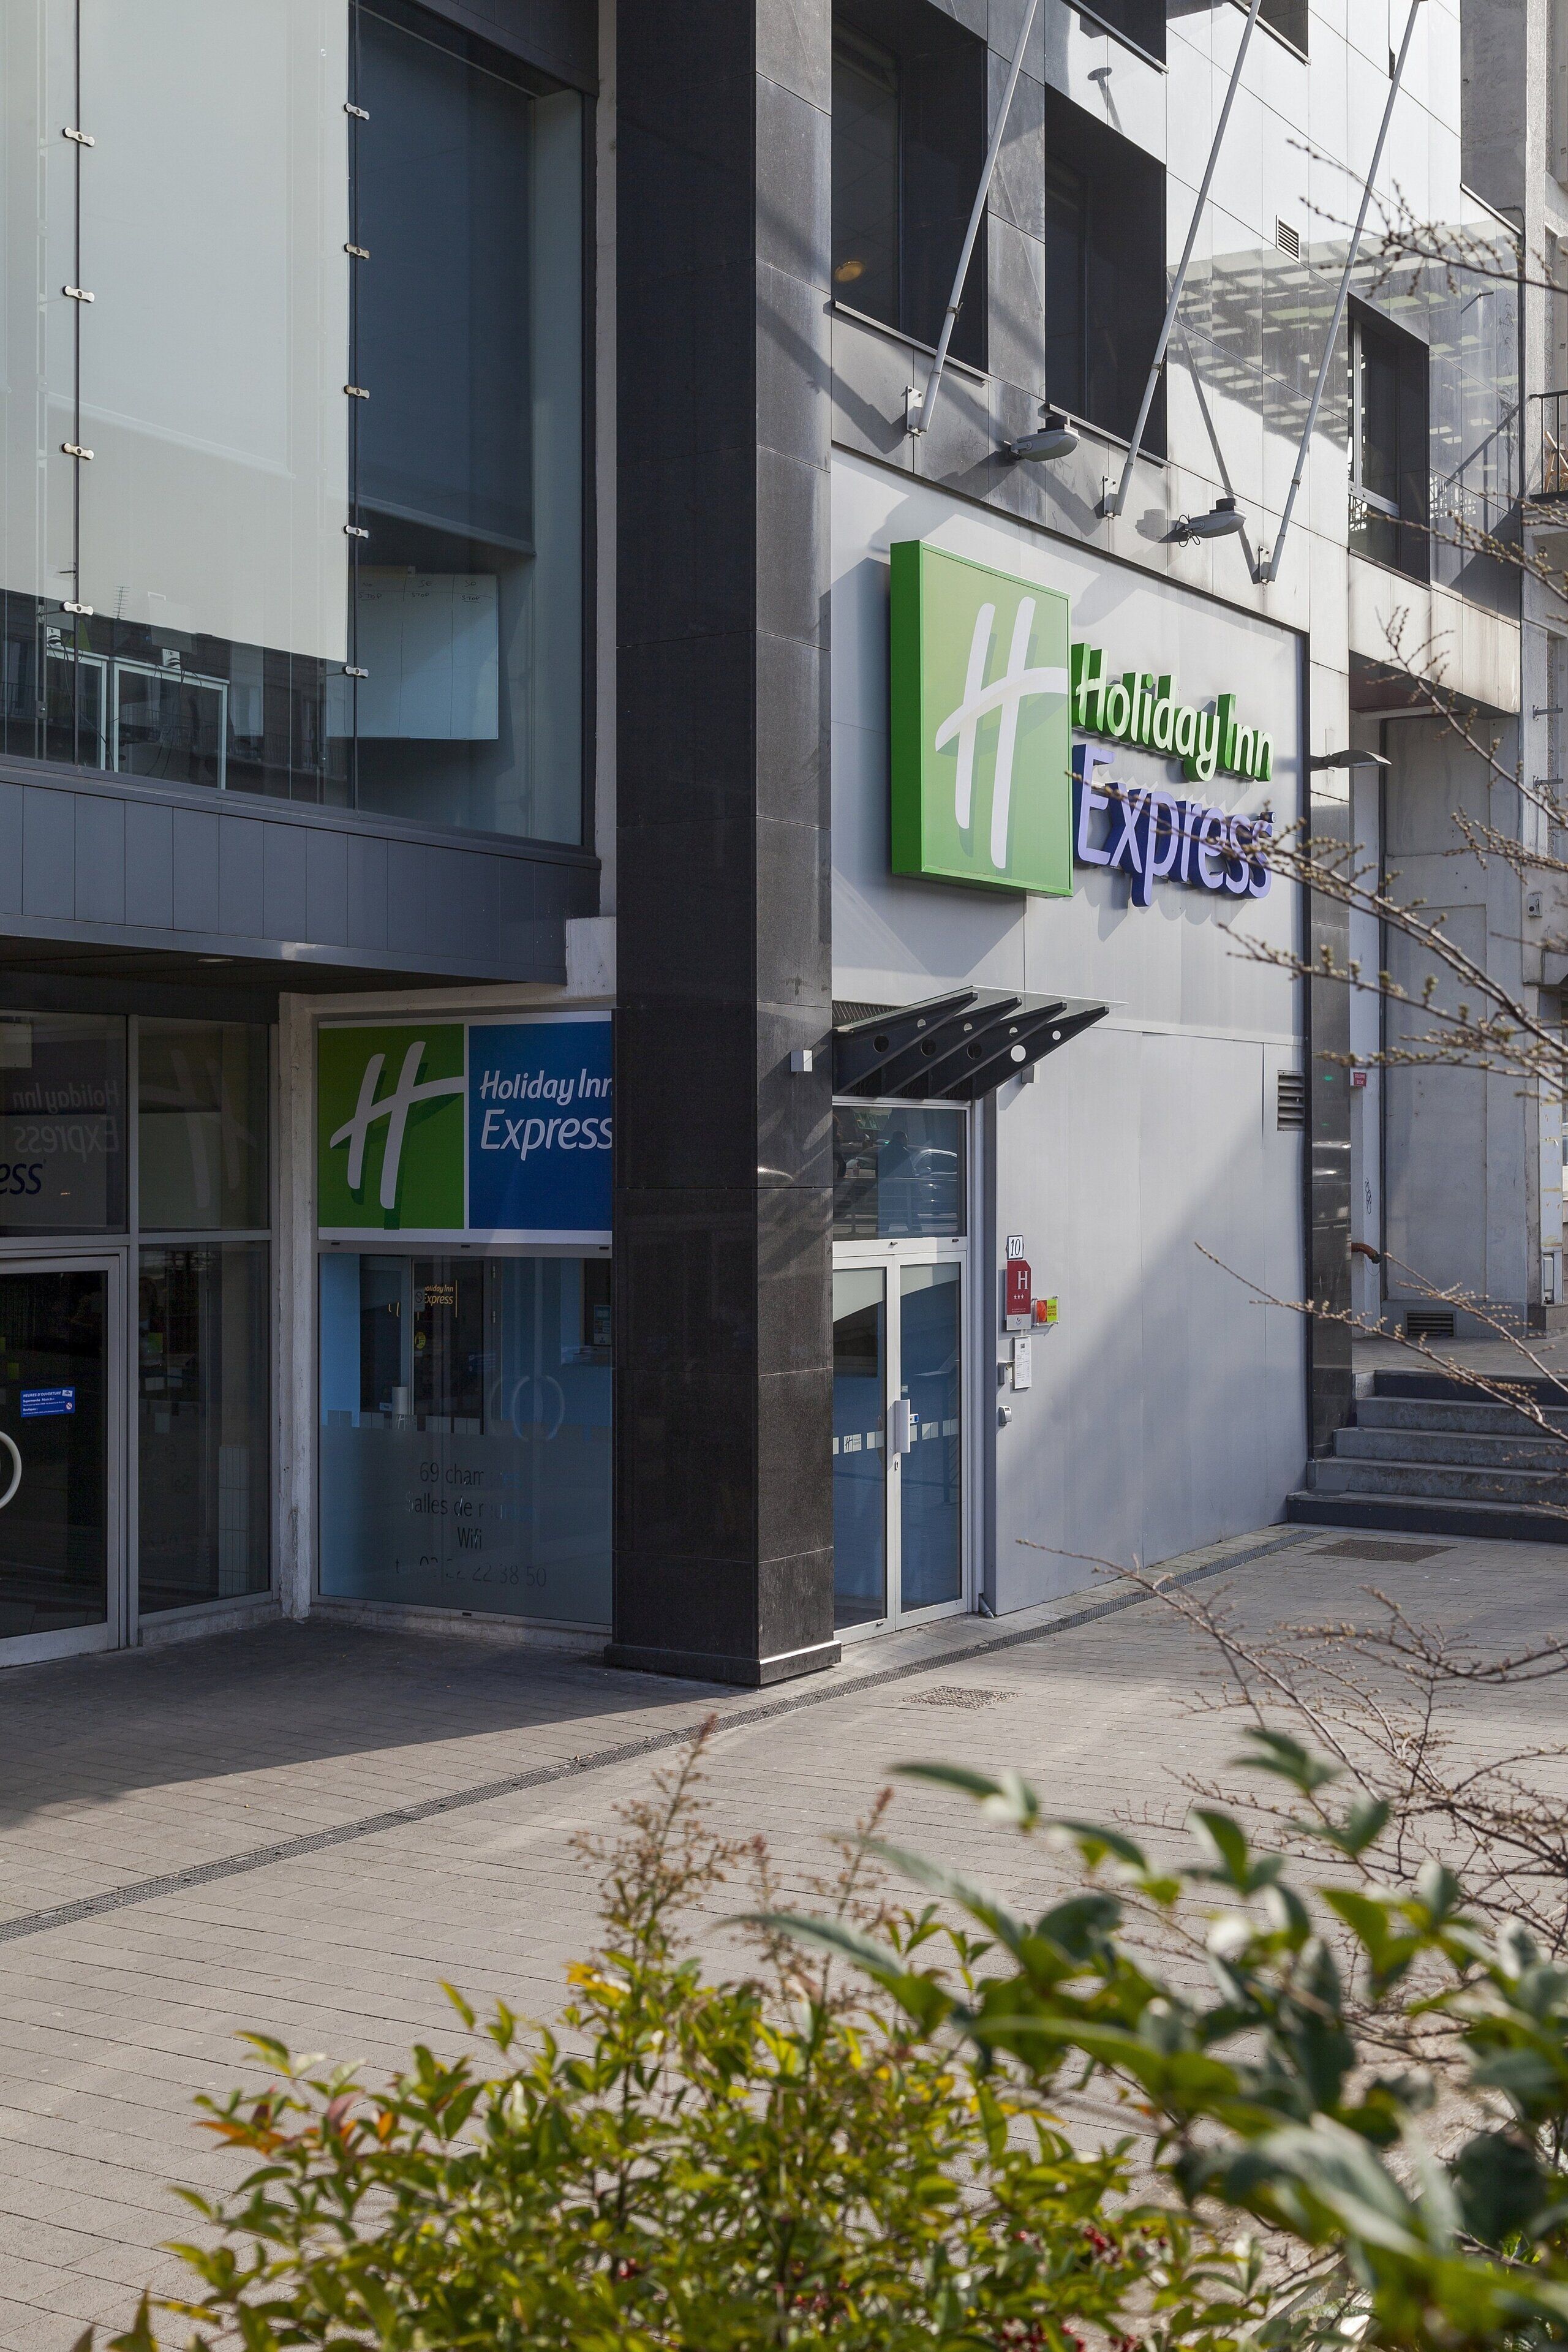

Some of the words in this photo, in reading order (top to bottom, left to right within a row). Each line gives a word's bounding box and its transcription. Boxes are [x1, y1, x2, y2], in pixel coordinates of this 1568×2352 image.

[1071, 643, 1220, 782] Holiday
[1218, 693, 1275, 782] Inn
[1073, 744, 1273, 907] Express
[480, 1070, 575, 1106] Holiday
[481, 1109, 612, 1161] Express
[1011, 1239, 1020, 1256] 10
[1017, 1270, 1028, 1290] H
[420, 1462, 439, 1482] 69
[454, 1495, 473, 1517] de
[458, 1527, 482, 1549] Wifi
[500, 1563, 519, 1585] 38
[526, 1566, 547, 1588] 50
